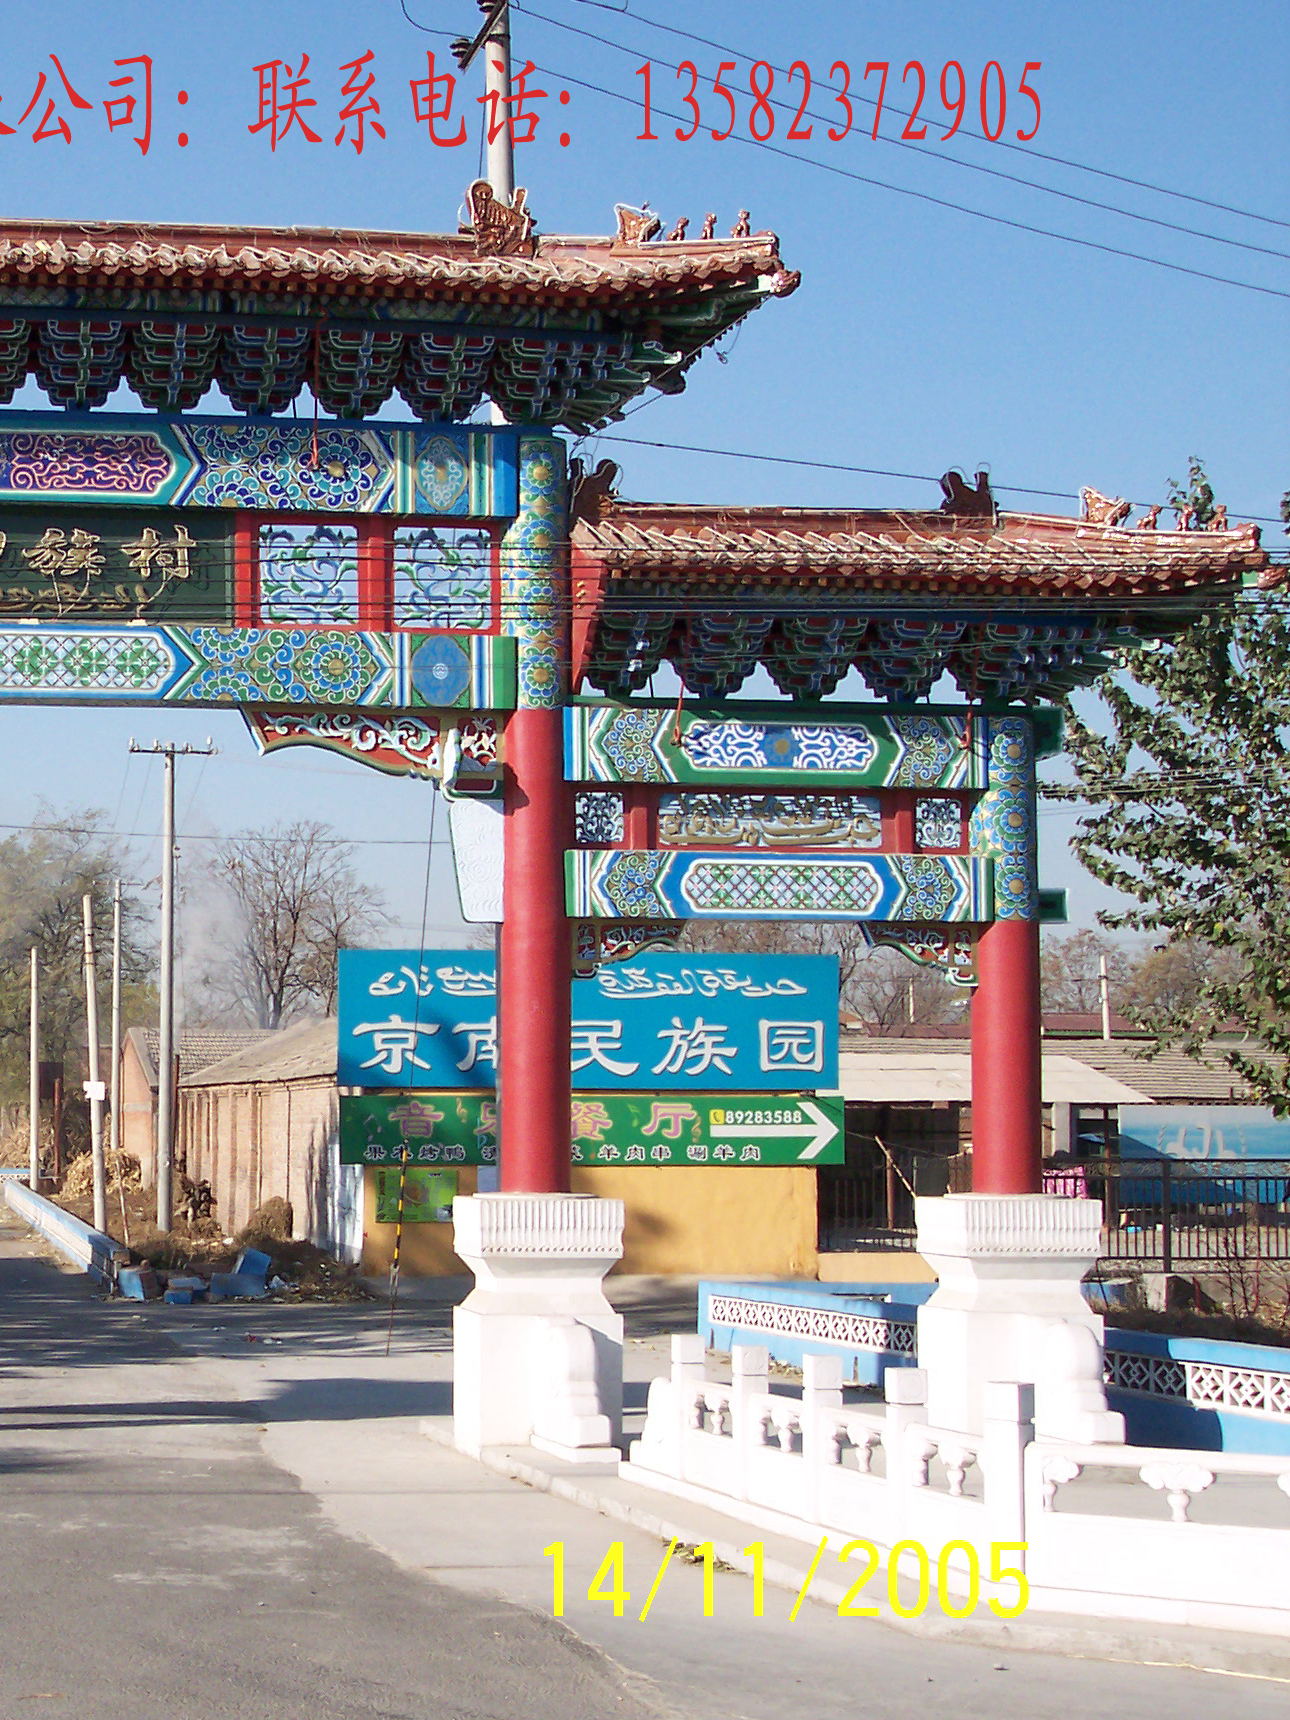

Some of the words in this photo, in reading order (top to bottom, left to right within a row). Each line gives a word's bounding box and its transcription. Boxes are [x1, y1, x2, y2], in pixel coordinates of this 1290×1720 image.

[724, 1110, 803, 1125] 89283588
[598, 1145, 672, 1162] 羊肉串
[687, 1145, 762, 1162] 涮羊肉
